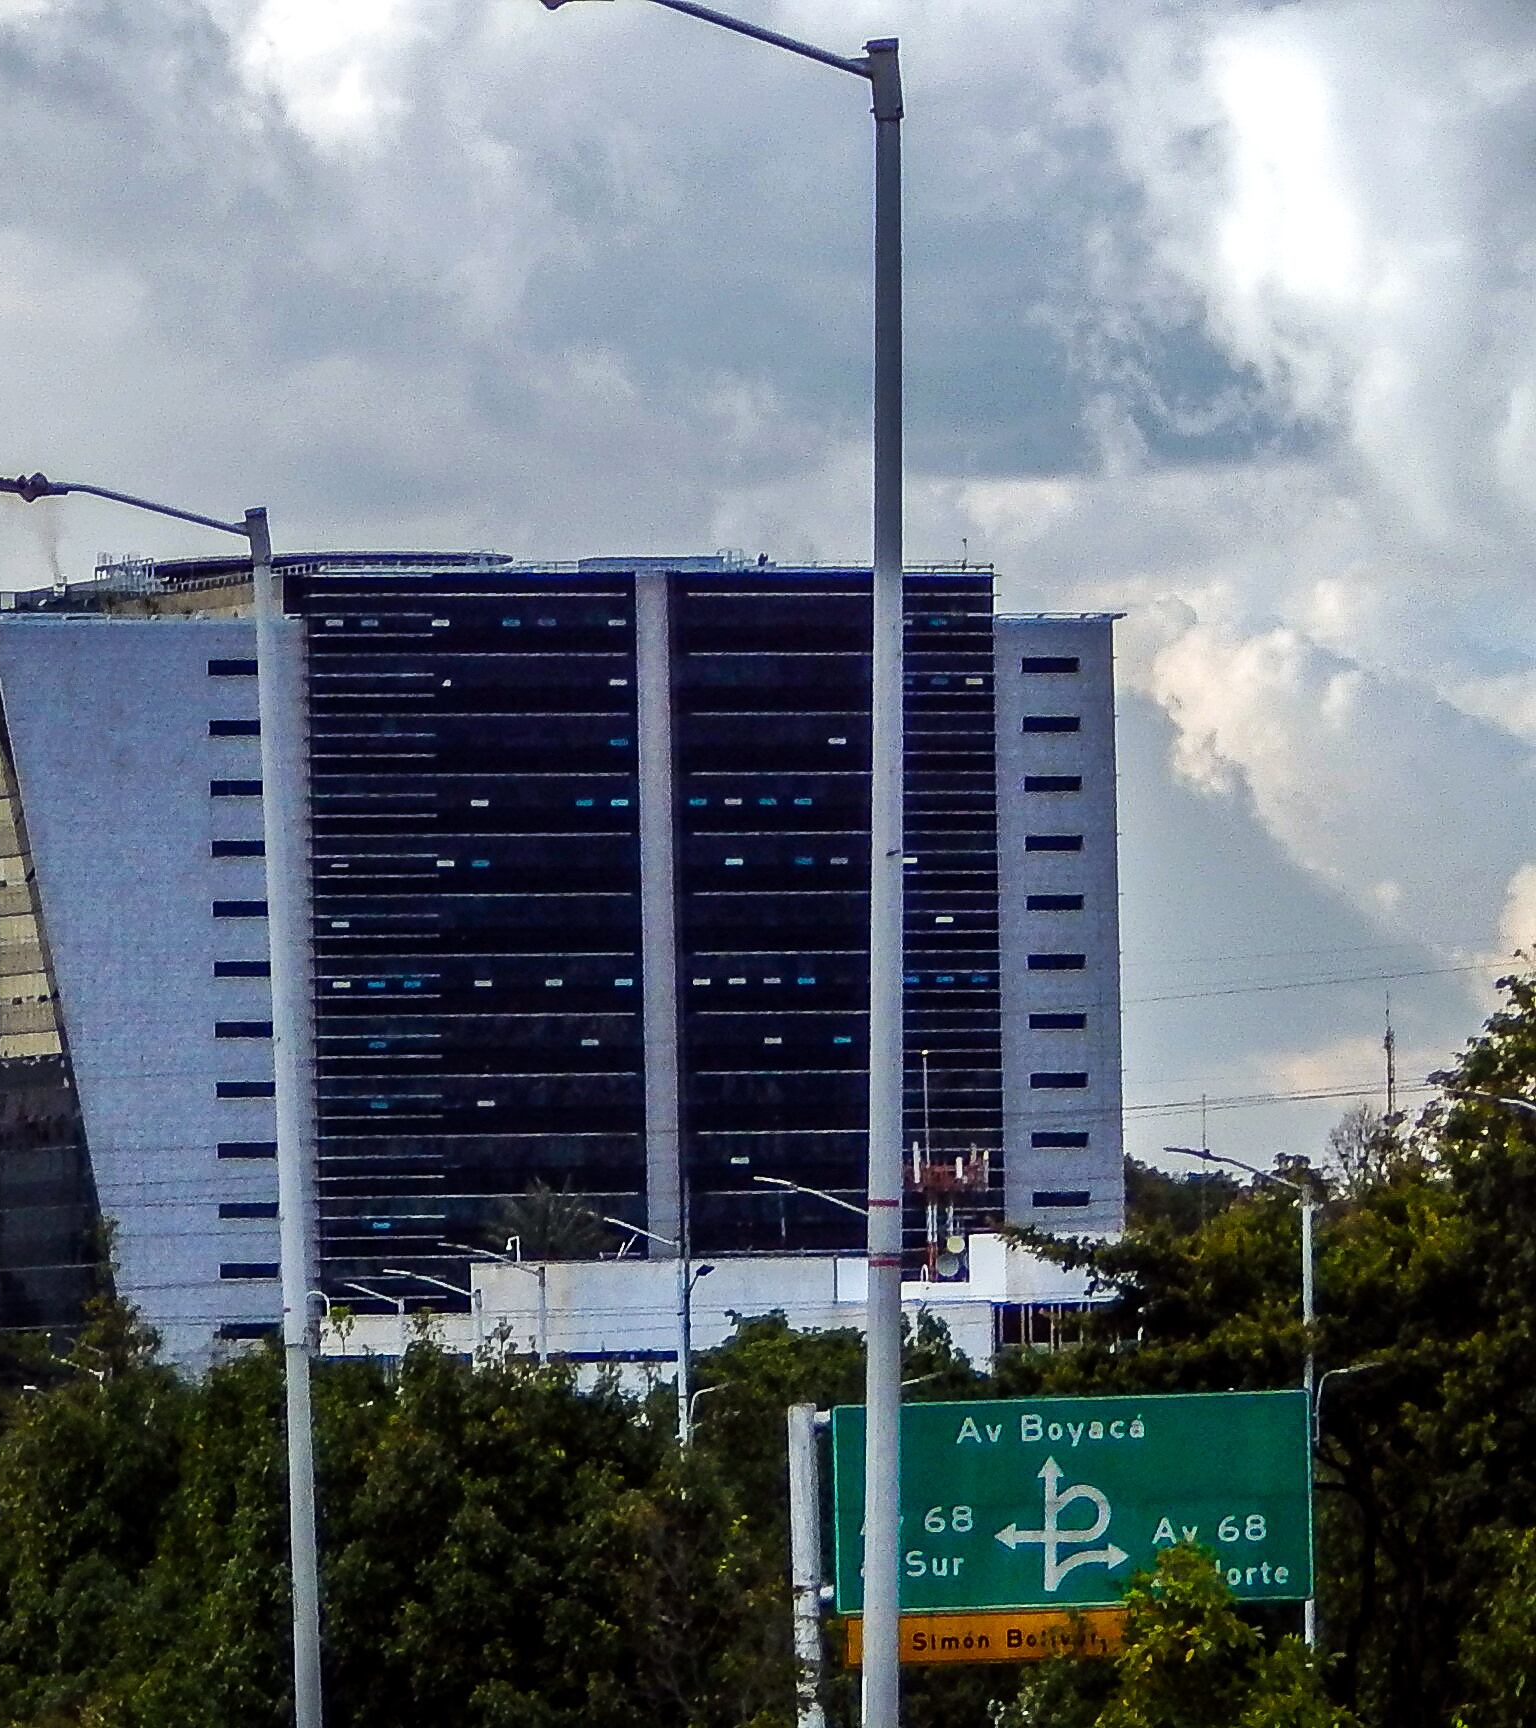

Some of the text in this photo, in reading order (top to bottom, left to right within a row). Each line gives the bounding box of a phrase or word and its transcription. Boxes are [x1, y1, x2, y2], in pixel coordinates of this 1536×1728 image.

[957, 1414, 1145, 1447] Av Boyacá
[924, 1505, 974, 1533] 68
[1151, 1513, 1267, 1546] Av 68
[905, 1550, 965, 1577] Sur
[1215, 1559, 1289, 1586] orte
[912, 1630, 990, 1651] Simón
